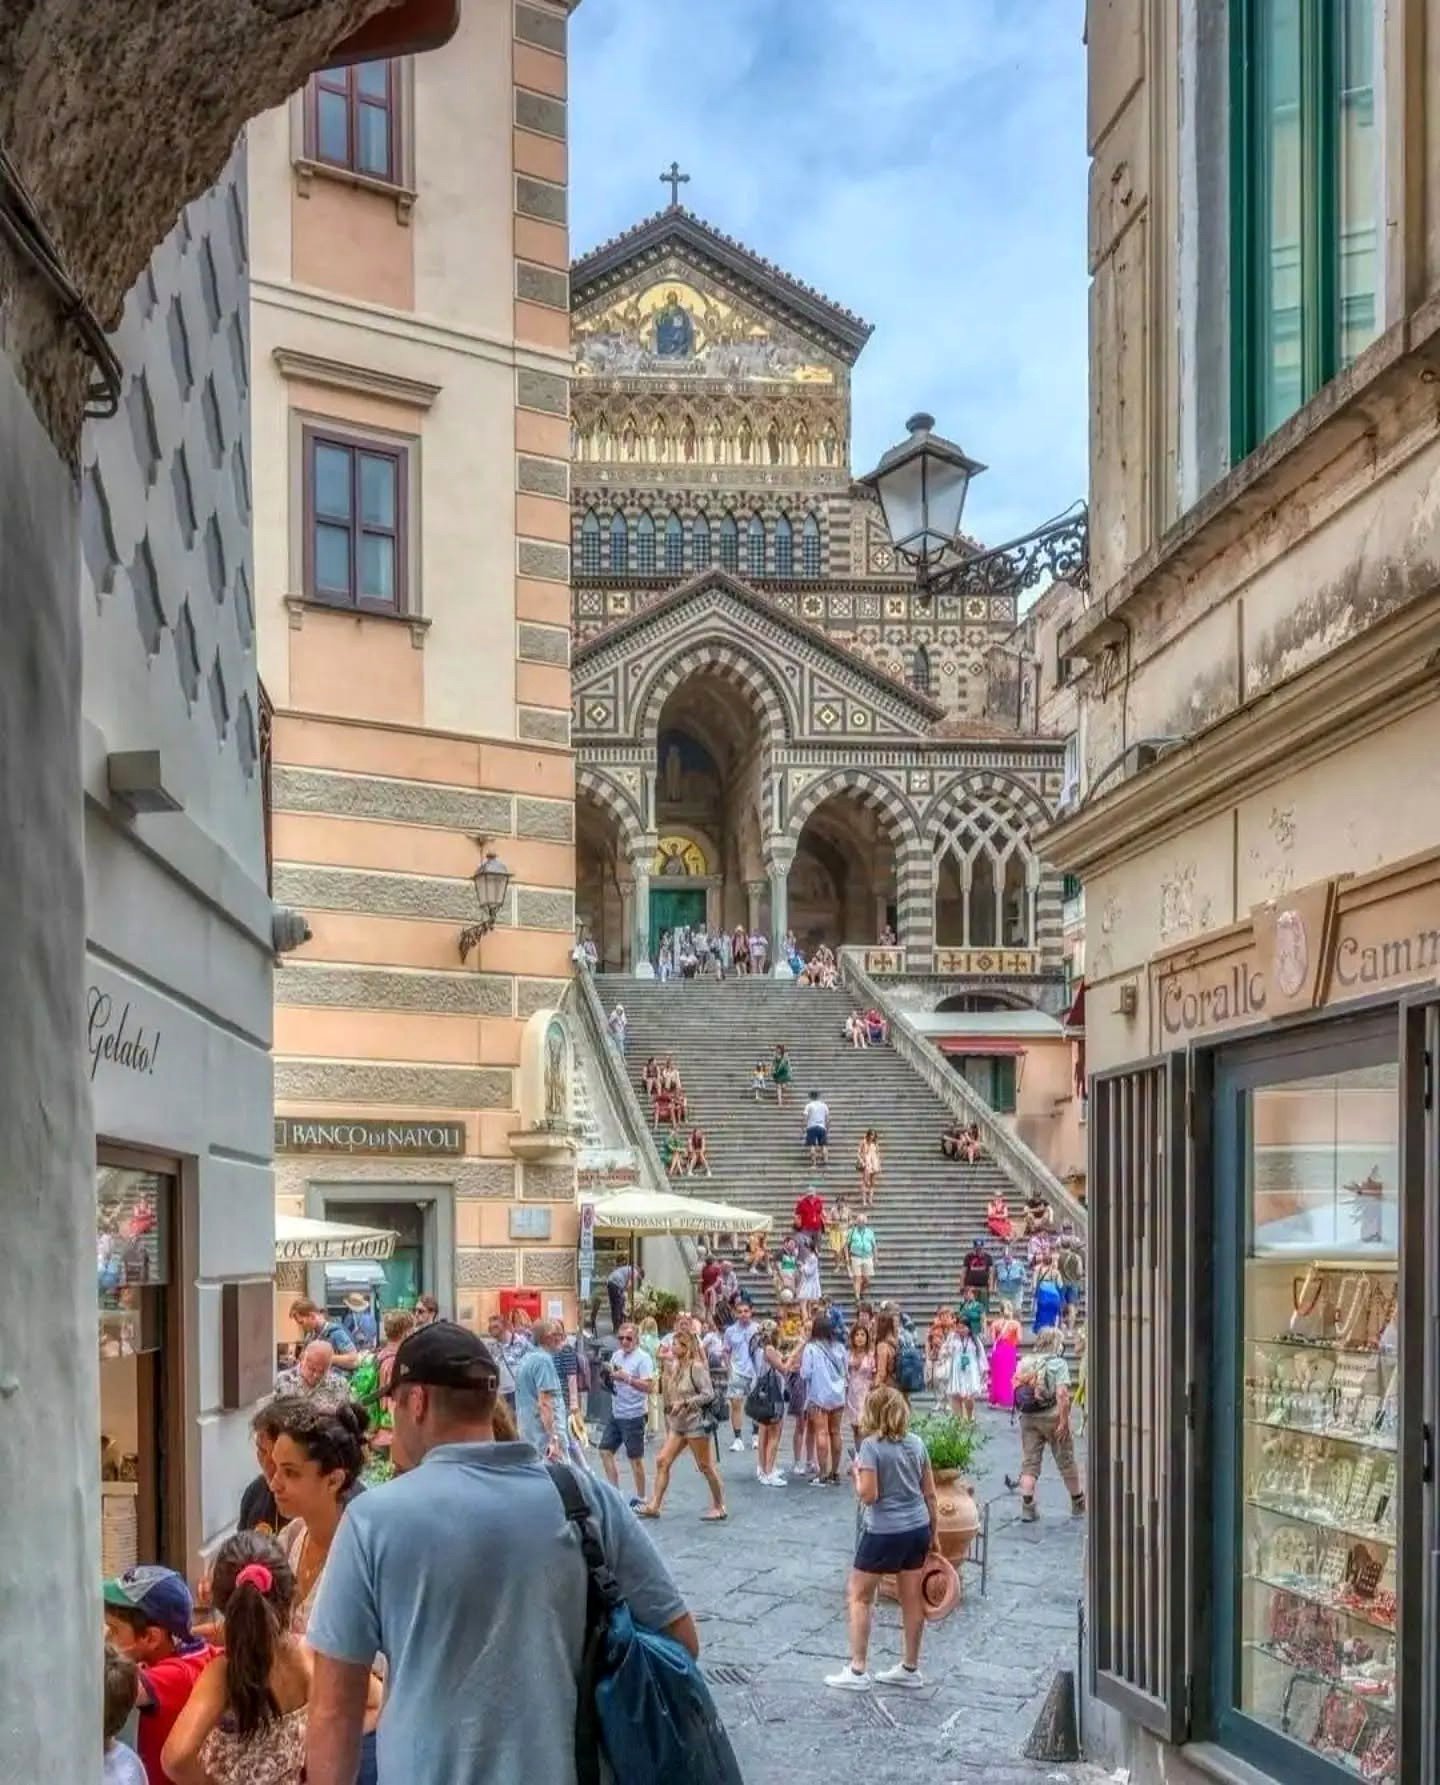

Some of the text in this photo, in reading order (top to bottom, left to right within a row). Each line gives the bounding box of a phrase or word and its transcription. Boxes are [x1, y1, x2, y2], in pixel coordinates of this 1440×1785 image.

[87, 986, 161, 1081] Gelato!
[292, 1124, 367, 1149] BANCO
[387, 1127, 460, 1150] NAPOLI
[680, 1216, 728, 1231] PIZZERIA
[341, 1239, 389, 1257] FOOD
